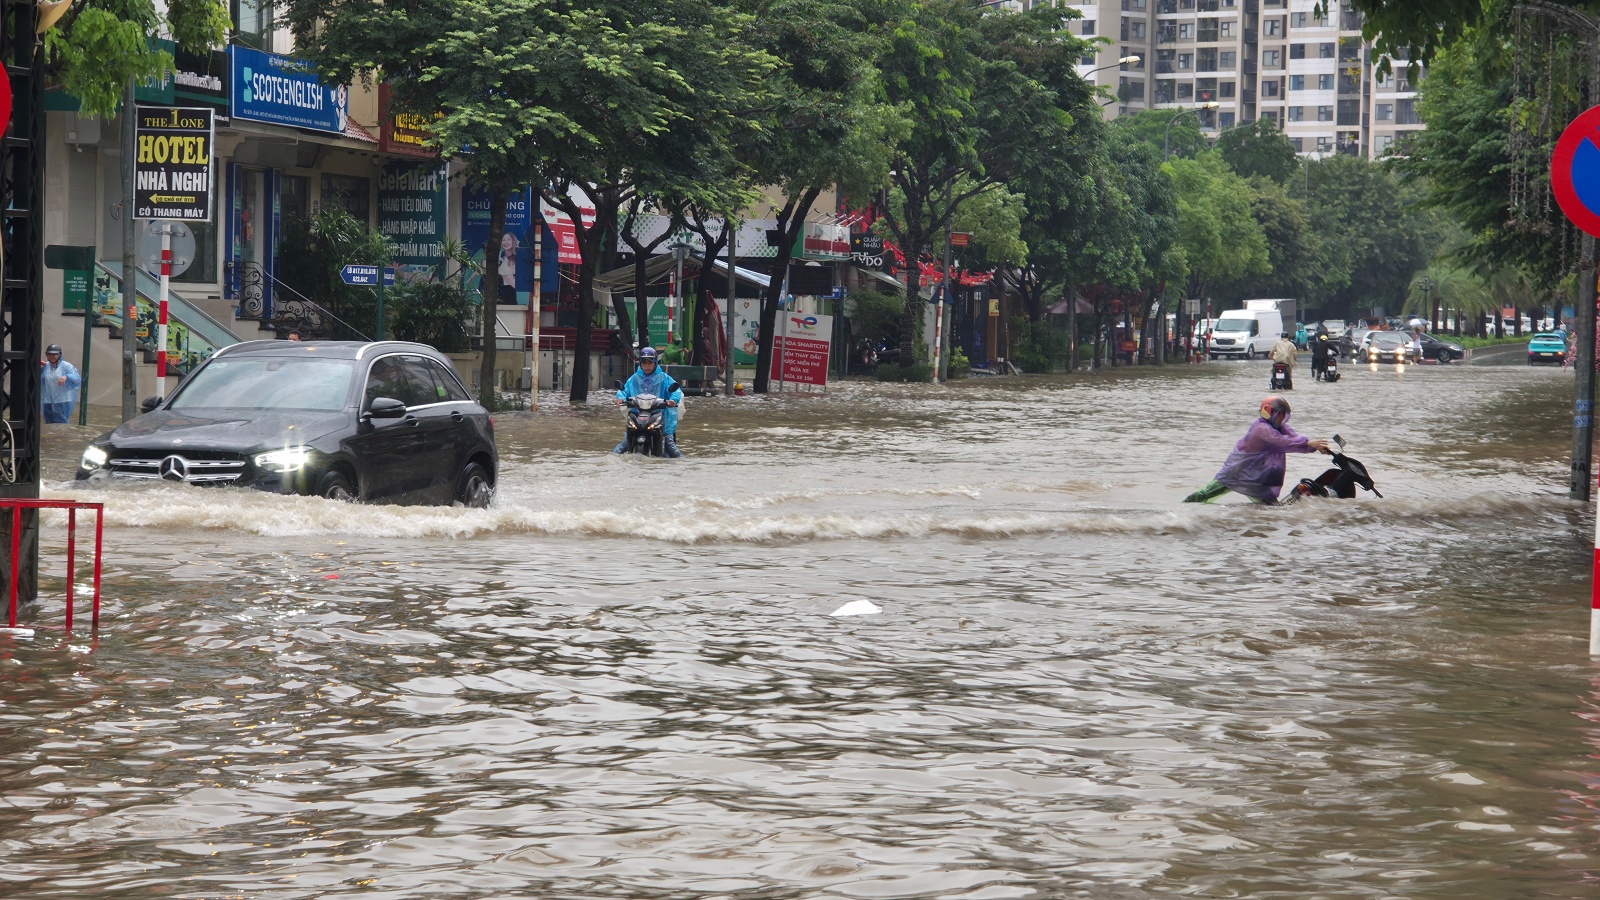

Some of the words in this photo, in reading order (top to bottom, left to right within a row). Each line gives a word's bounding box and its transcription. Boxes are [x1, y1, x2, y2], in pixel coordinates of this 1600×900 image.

[253, 72, 323, 110] SCOTSENGLISH
[144, 118, 168, 127] THE
[180, 118, 204, 128] ONE
[138, 136, 208, 164] HOTEL
[138, 168, 168, 190] NHÀ
[172, 166, 207, 192] NGHỈ
[382, 196, 399, 212] HÀNG
[401, 196, 414, 212] TIÊU
[416, 196, 432, 212] DÙNG
[468, 198, 490, 210] CHỦ
[139, 206, 151, 216] CÓ
[153, 208, 182, 217] THANG
[184, 208, 204, 218] MÁY
[419, 244, 428, 257] AN
